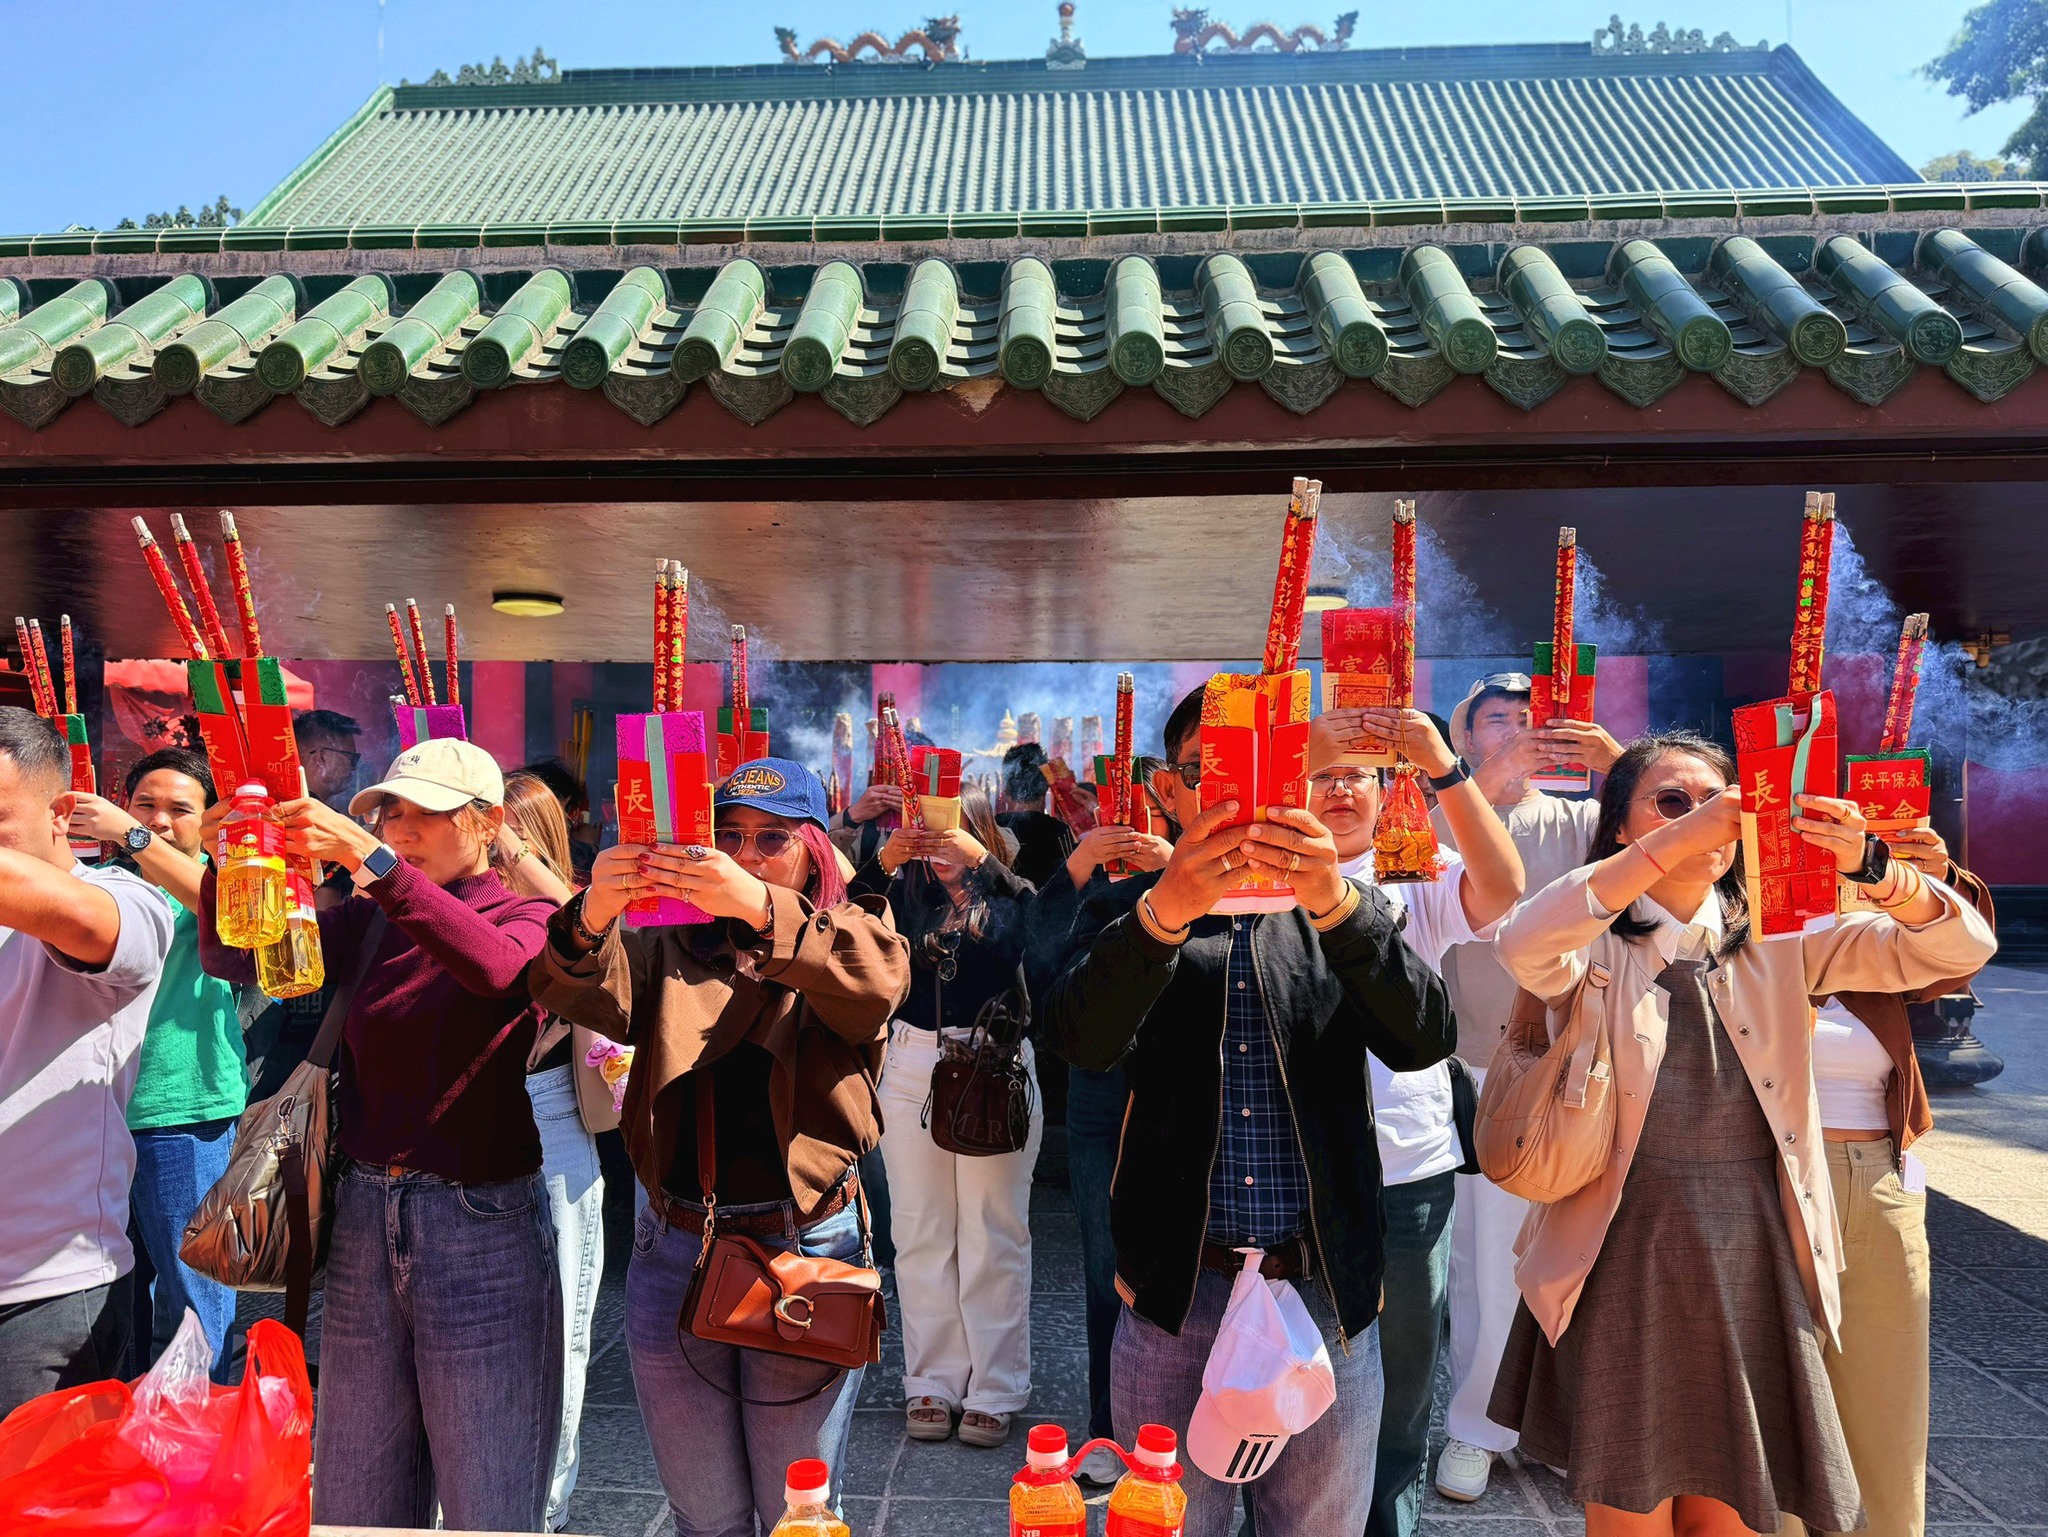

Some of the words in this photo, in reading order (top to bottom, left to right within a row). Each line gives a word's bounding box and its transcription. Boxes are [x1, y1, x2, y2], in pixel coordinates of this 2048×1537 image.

[623, 778, 653, 815] 長
[741, 769, 780, 787] JEANS
[1746, 768, 1781, 812] 長
